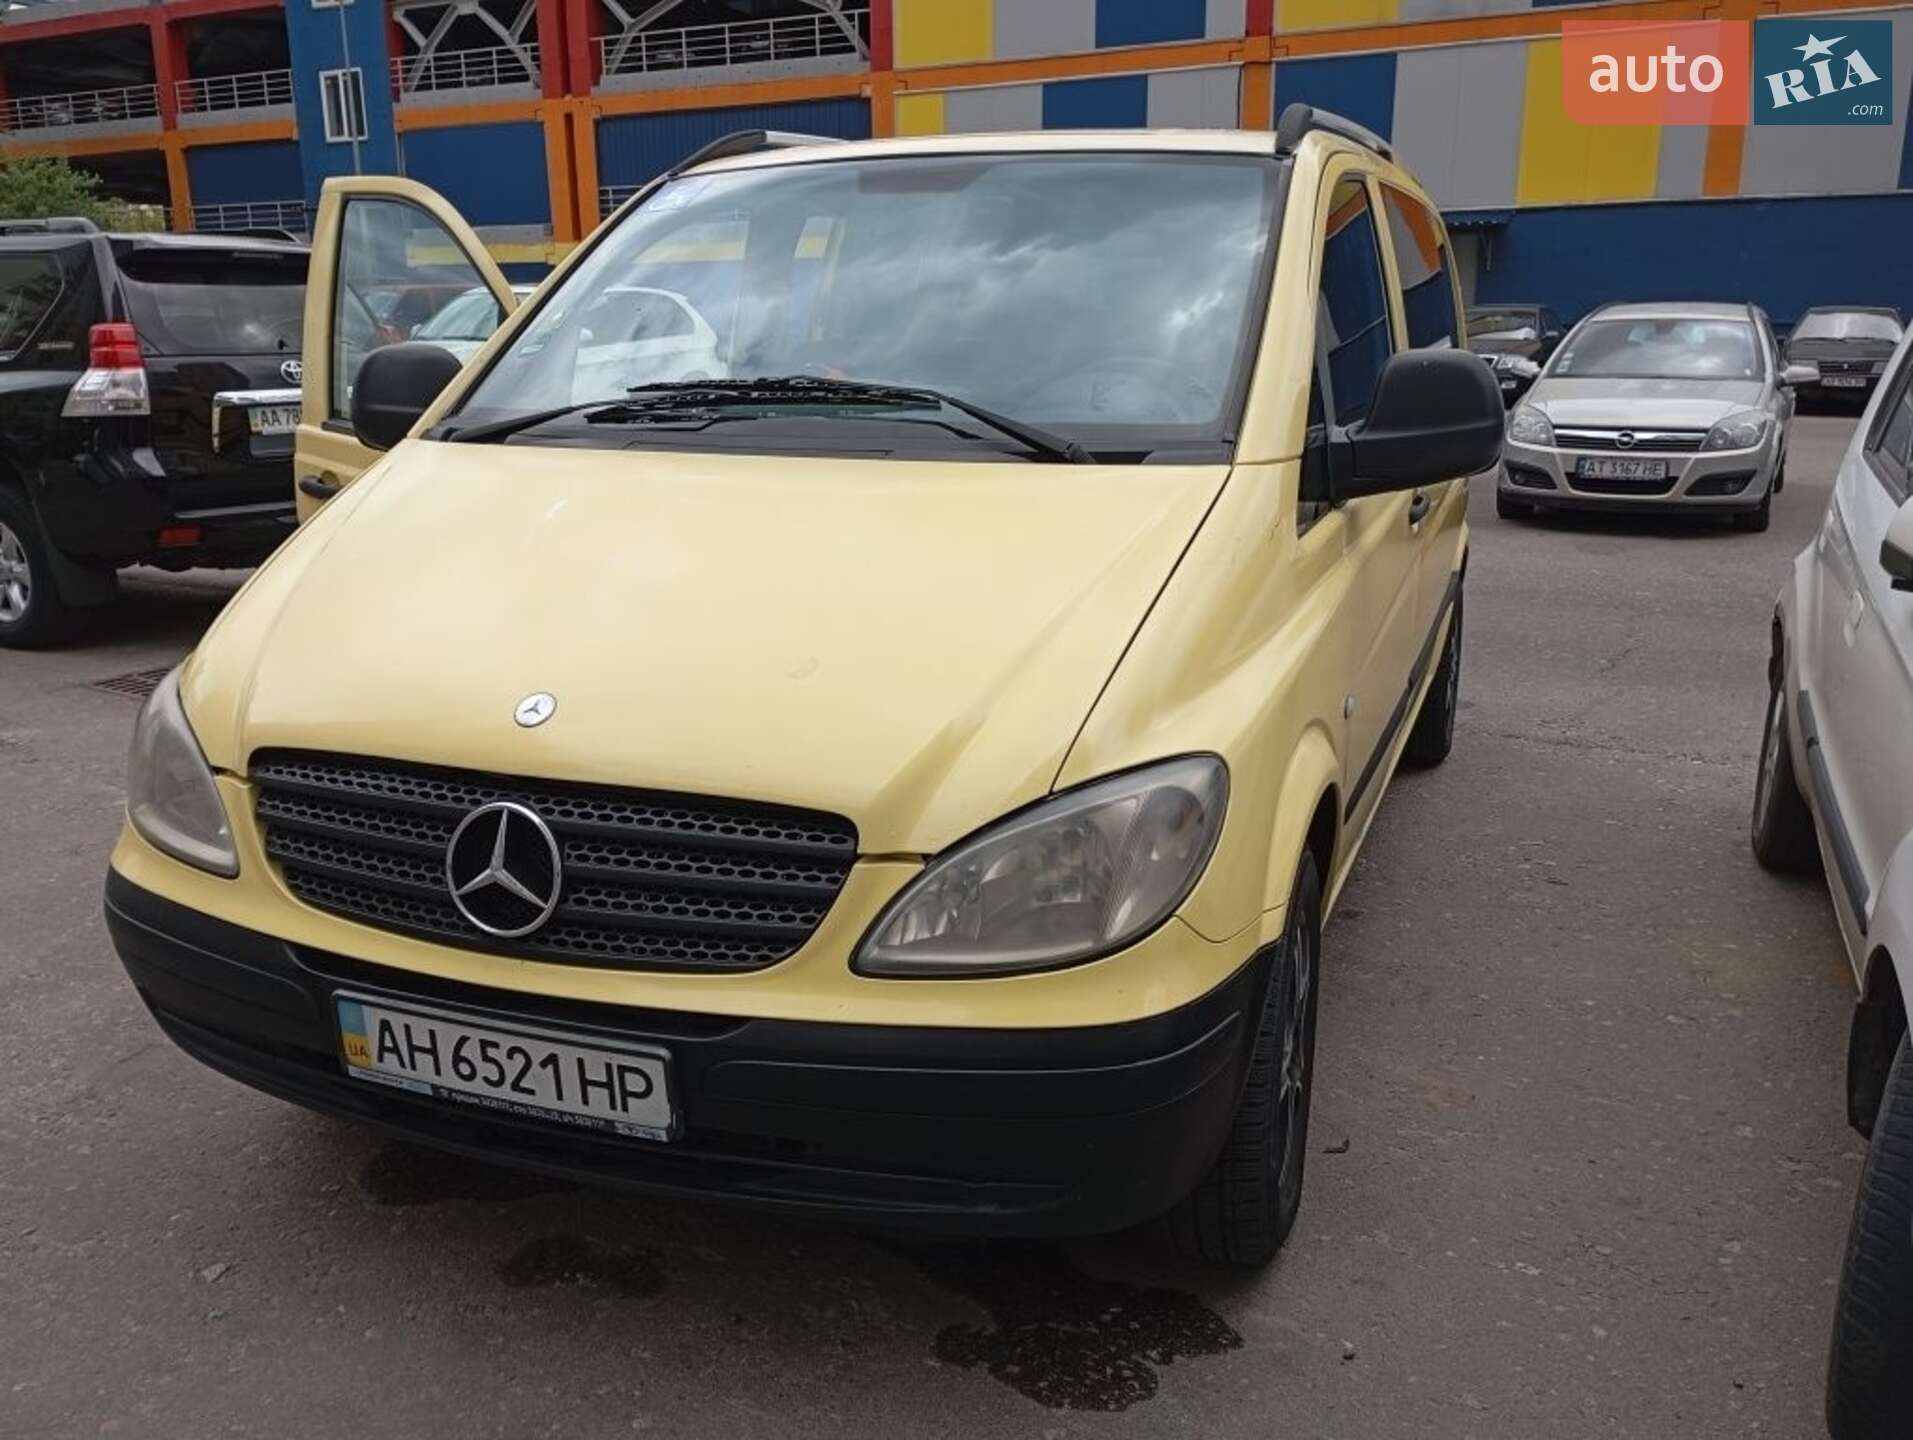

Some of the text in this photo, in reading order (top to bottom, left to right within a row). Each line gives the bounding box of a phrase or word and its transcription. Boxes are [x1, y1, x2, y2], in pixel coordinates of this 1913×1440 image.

[261, 408, 302, 426] AA 78
[1587, 461, 1606, 472] AT
[347, 1041, 369, 1058] UA
[376, 1018, 442, 1077] AH
[451, 1034, 565, 1101] 6521
[576, 1056, 654, 1113] HP
